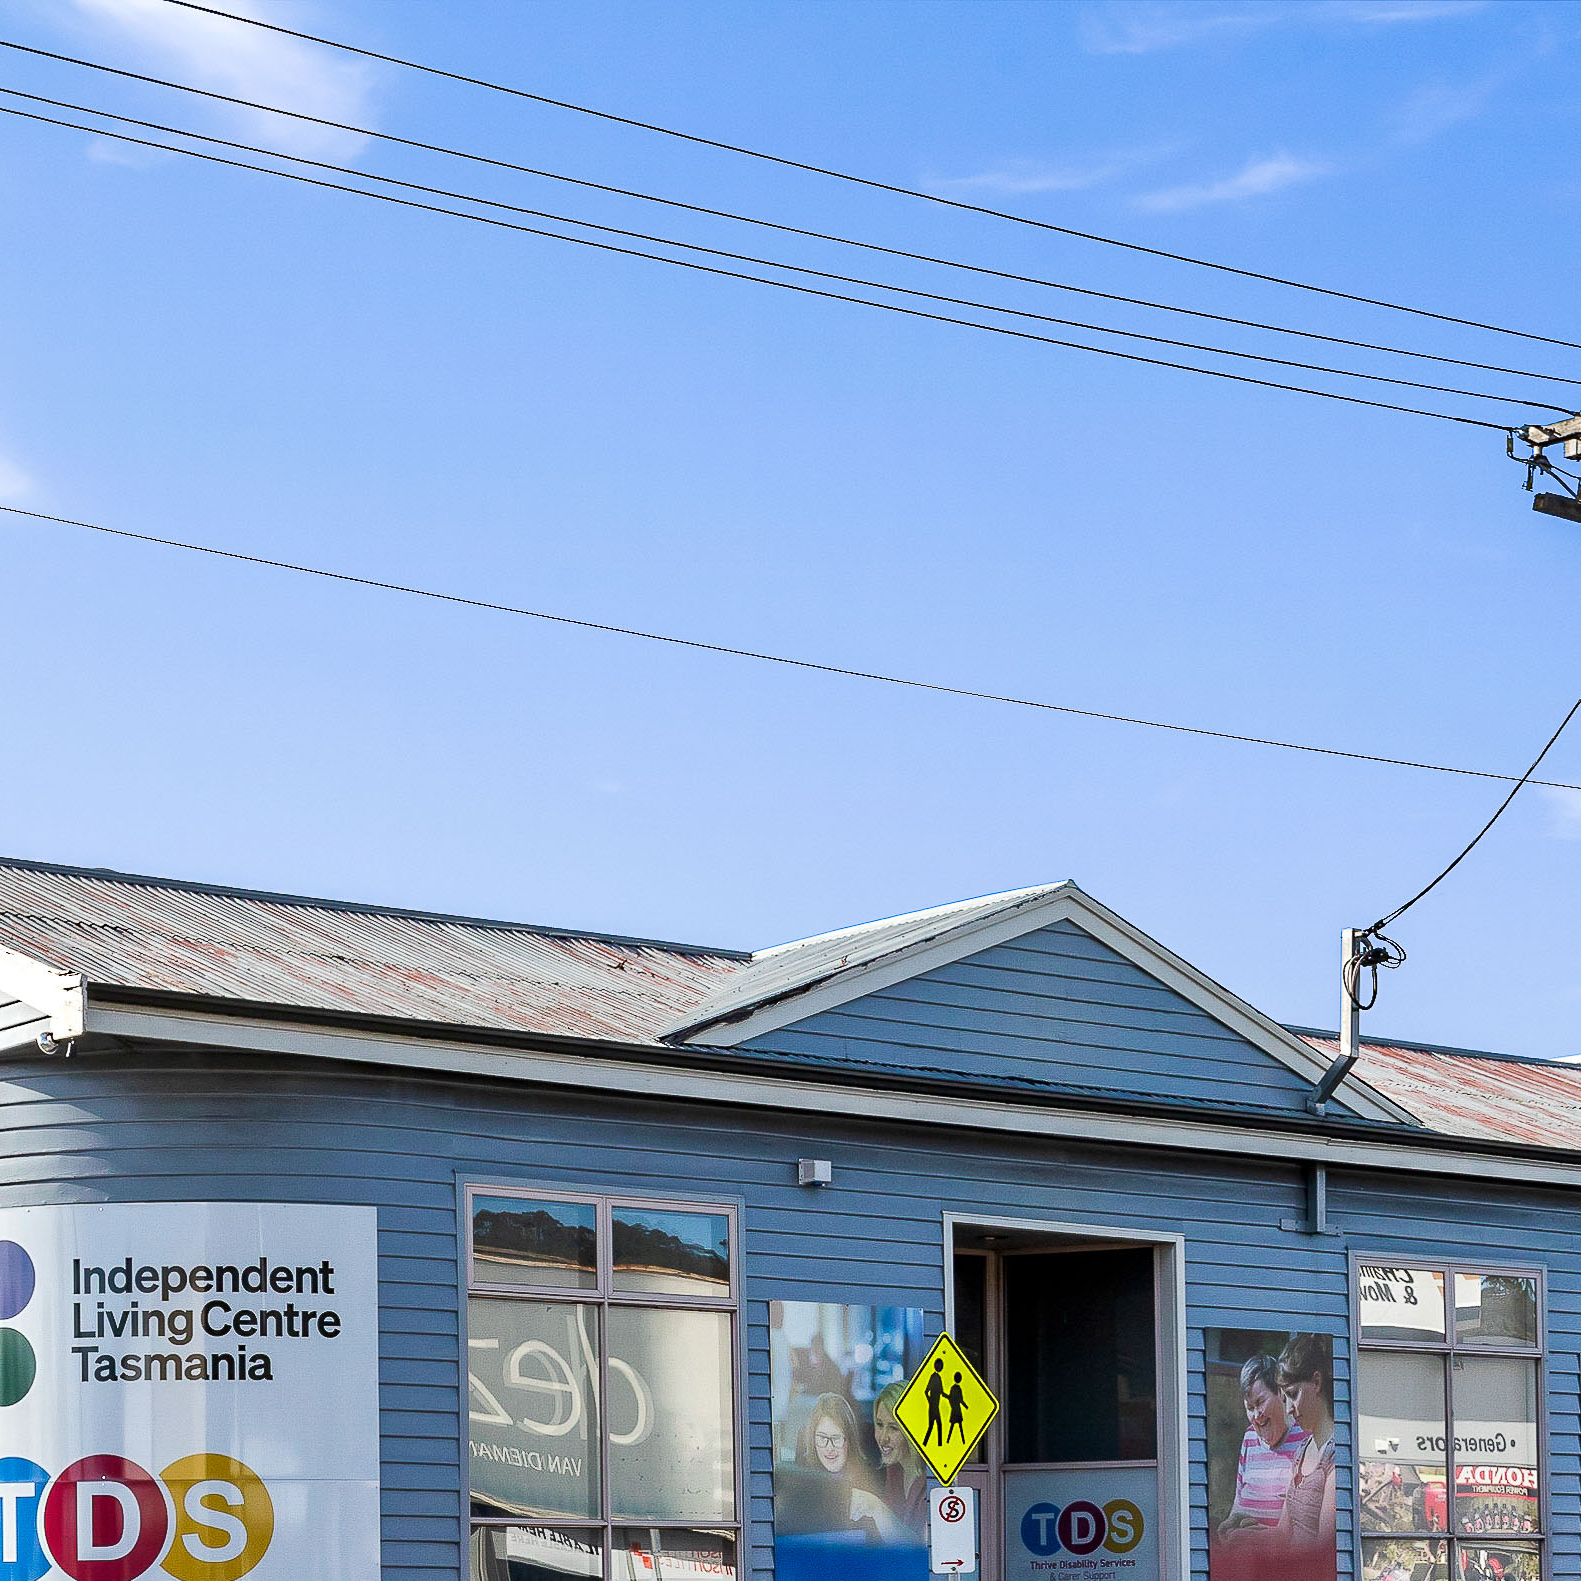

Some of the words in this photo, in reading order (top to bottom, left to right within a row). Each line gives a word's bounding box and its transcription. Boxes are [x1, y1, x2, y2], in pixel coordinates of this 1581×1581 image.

[73, 1257, 335, 1302] Independent
[73, 1301, 194, 1345] Living
[201, 1300, 341, 1338] Centre
[72, 1345, 273, 1382] Tasmania
[1032, 1509, 1134, 1546] TDS
[1030, 1561, 1057, 1570] Thrive
[1059, 1559, 1097, 1570] Disability
[1100, 1558, 1136, 1568] Services
[1050, 1572, 1056, 1581] &
[1059, 1571, 1080, 1580] Carer
[1083, 1571, 1116, 1581] Support
